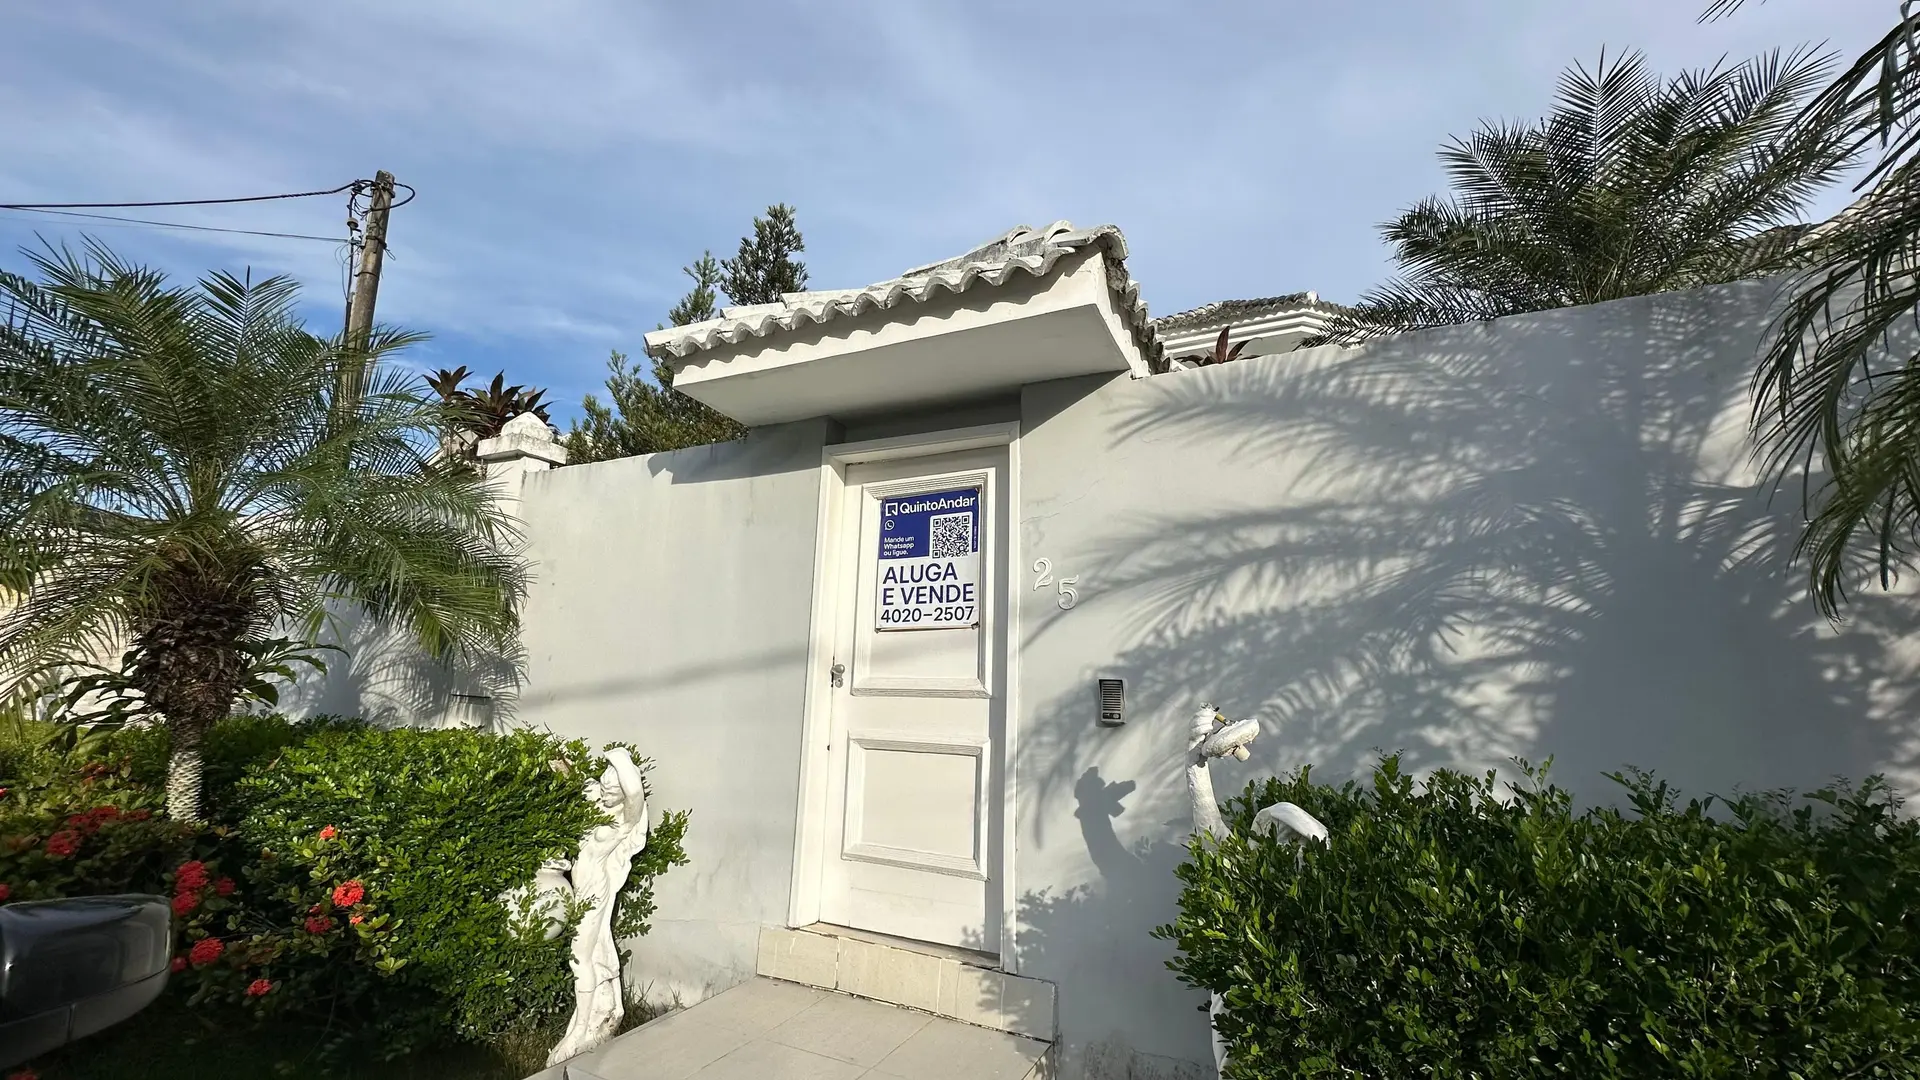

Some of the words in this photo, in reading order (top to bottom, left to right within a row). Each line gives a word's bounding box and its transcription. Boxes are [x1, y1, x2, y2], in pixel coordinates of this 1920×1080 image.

[900, 496, 976, 514] QuintoAndar
[883, 542, 915, 550] Whatsapp
[892, 549, 909, 557] ligue.
[882, 562, 958, 584] ALUGA
[882, 587, 895, 606] E
[900, 583, 975, 605] VENDE
[880, 606, 975, 623] 4020-2507
